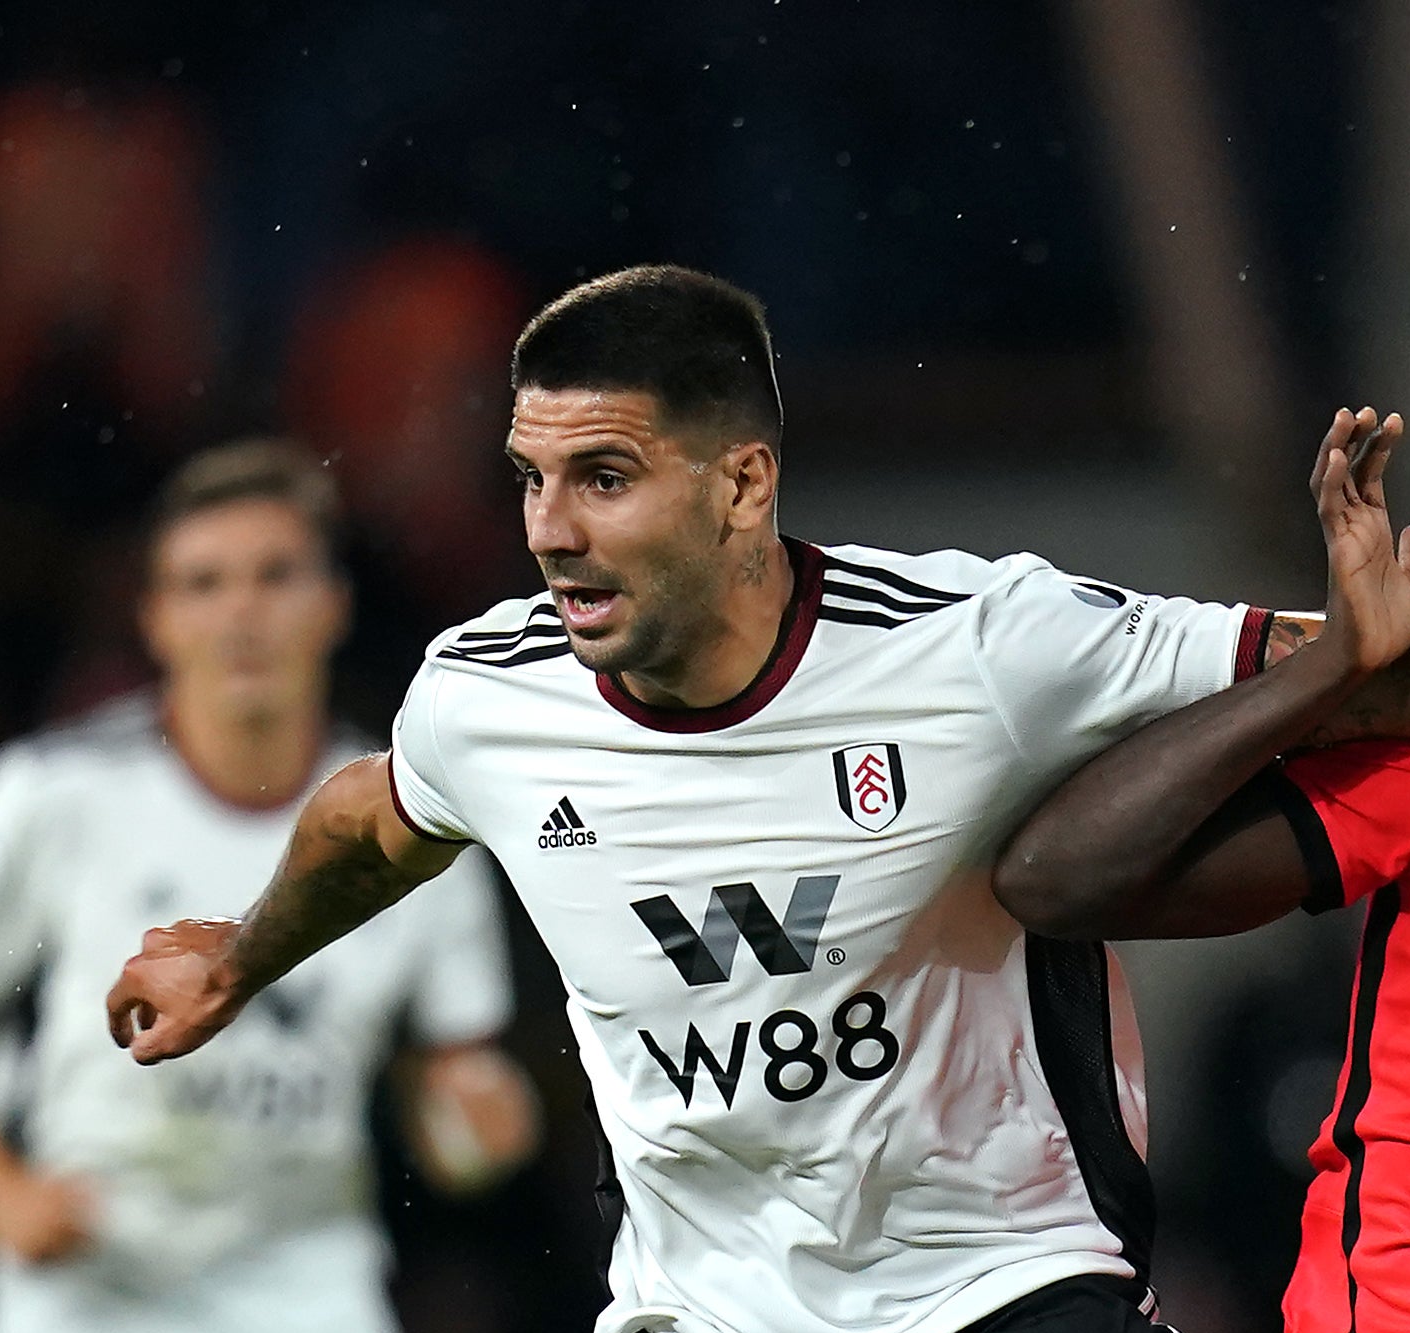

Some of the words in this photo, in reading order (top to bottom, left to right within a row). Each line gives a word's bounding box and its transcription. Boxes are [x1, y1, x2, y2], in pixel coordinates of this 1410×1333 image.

[1125, 597, 1149, 636] WORL
[852, 753, 889, 815] FFC
[538, 828, 597, 850] adidas
[637, 990, 900, 1112] W88
